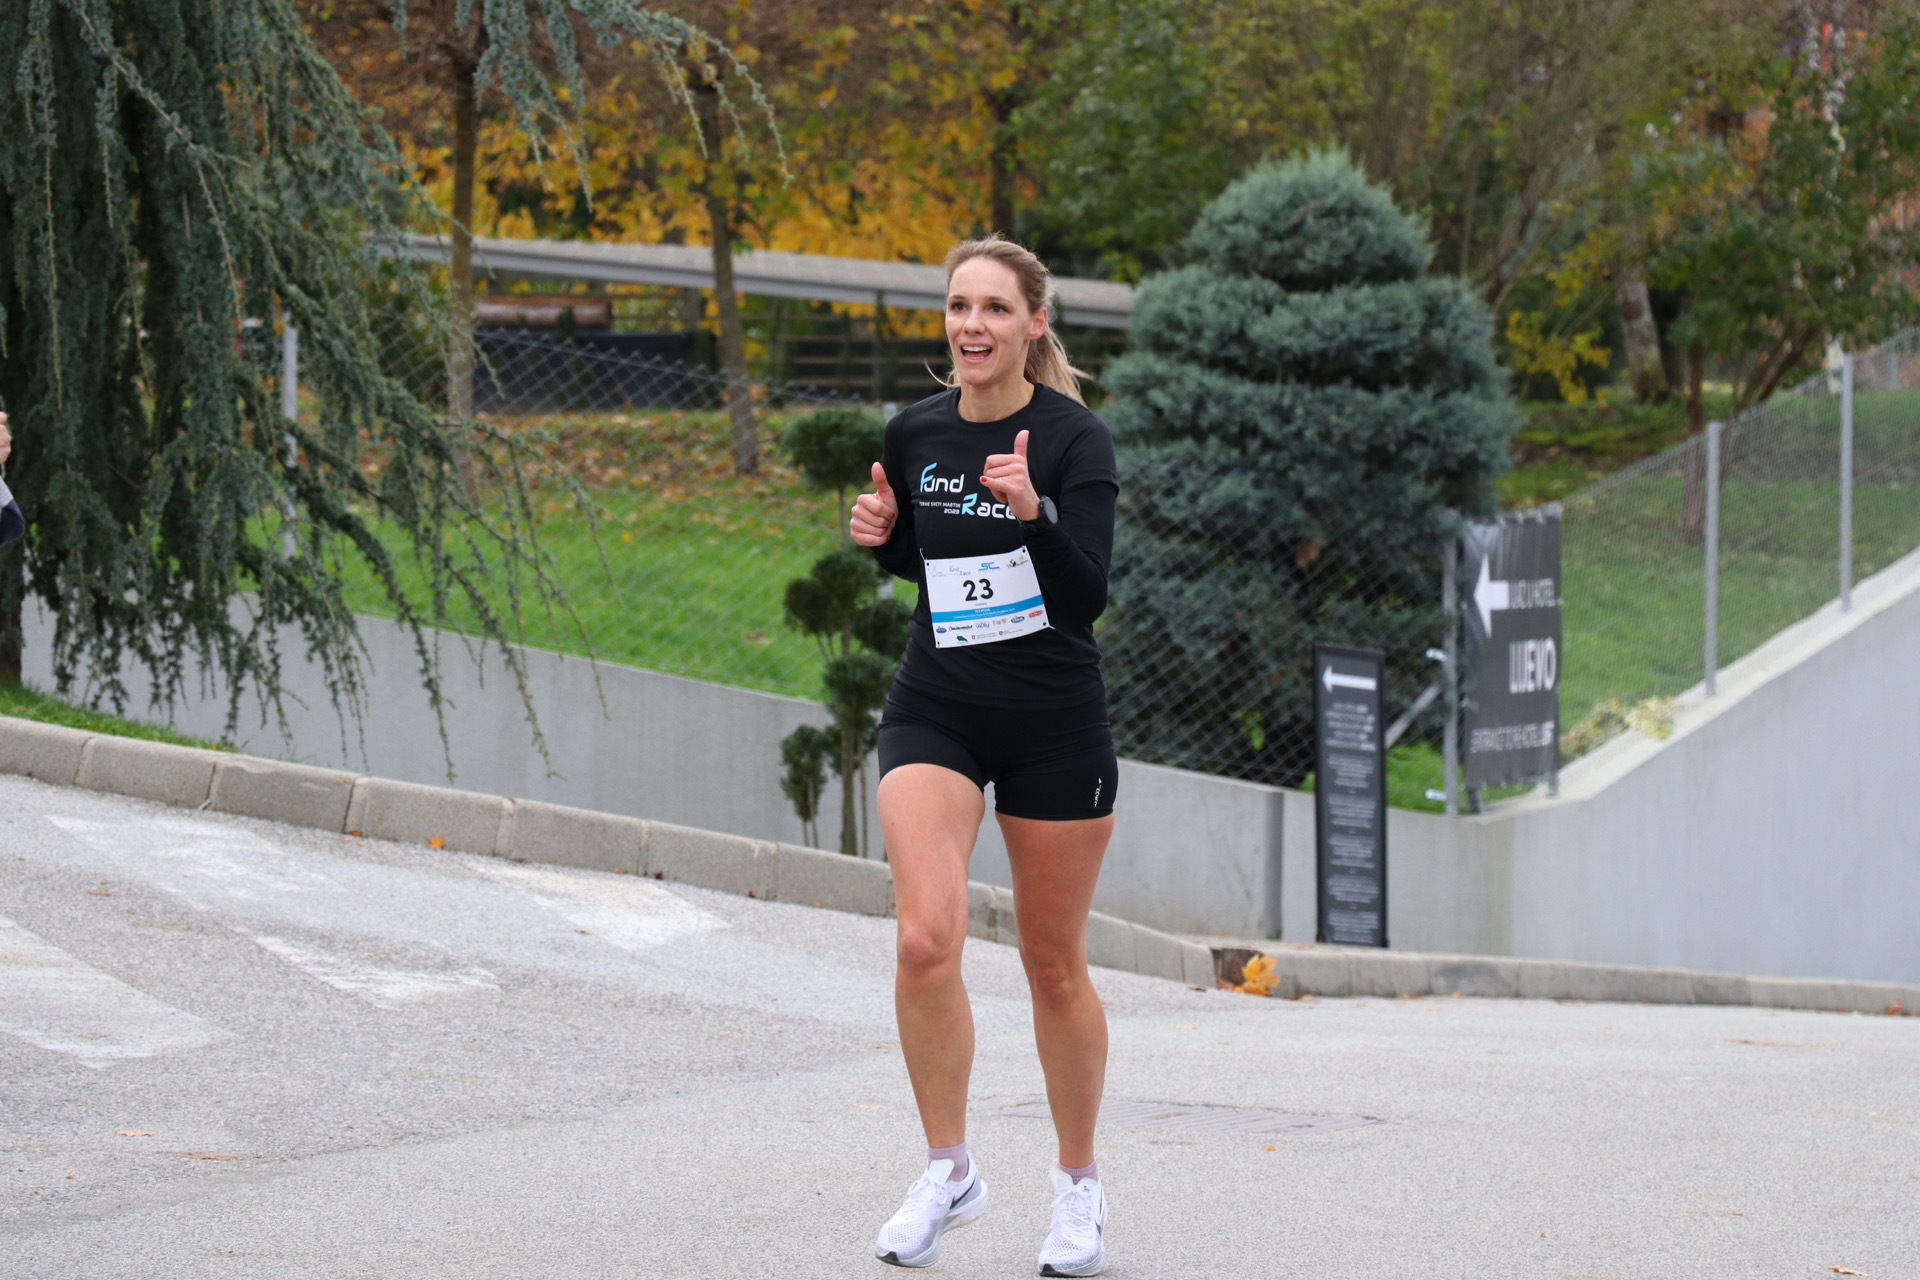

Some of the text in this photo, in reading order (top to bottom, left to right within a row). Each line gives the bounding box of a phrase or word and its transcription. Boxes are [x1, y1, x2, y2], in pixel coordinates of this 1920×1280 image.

[920, 462, 965, 493] Fund
[963, 578, 994, 601] 23
[1509, 637, 1556, 693] LIJEVO
